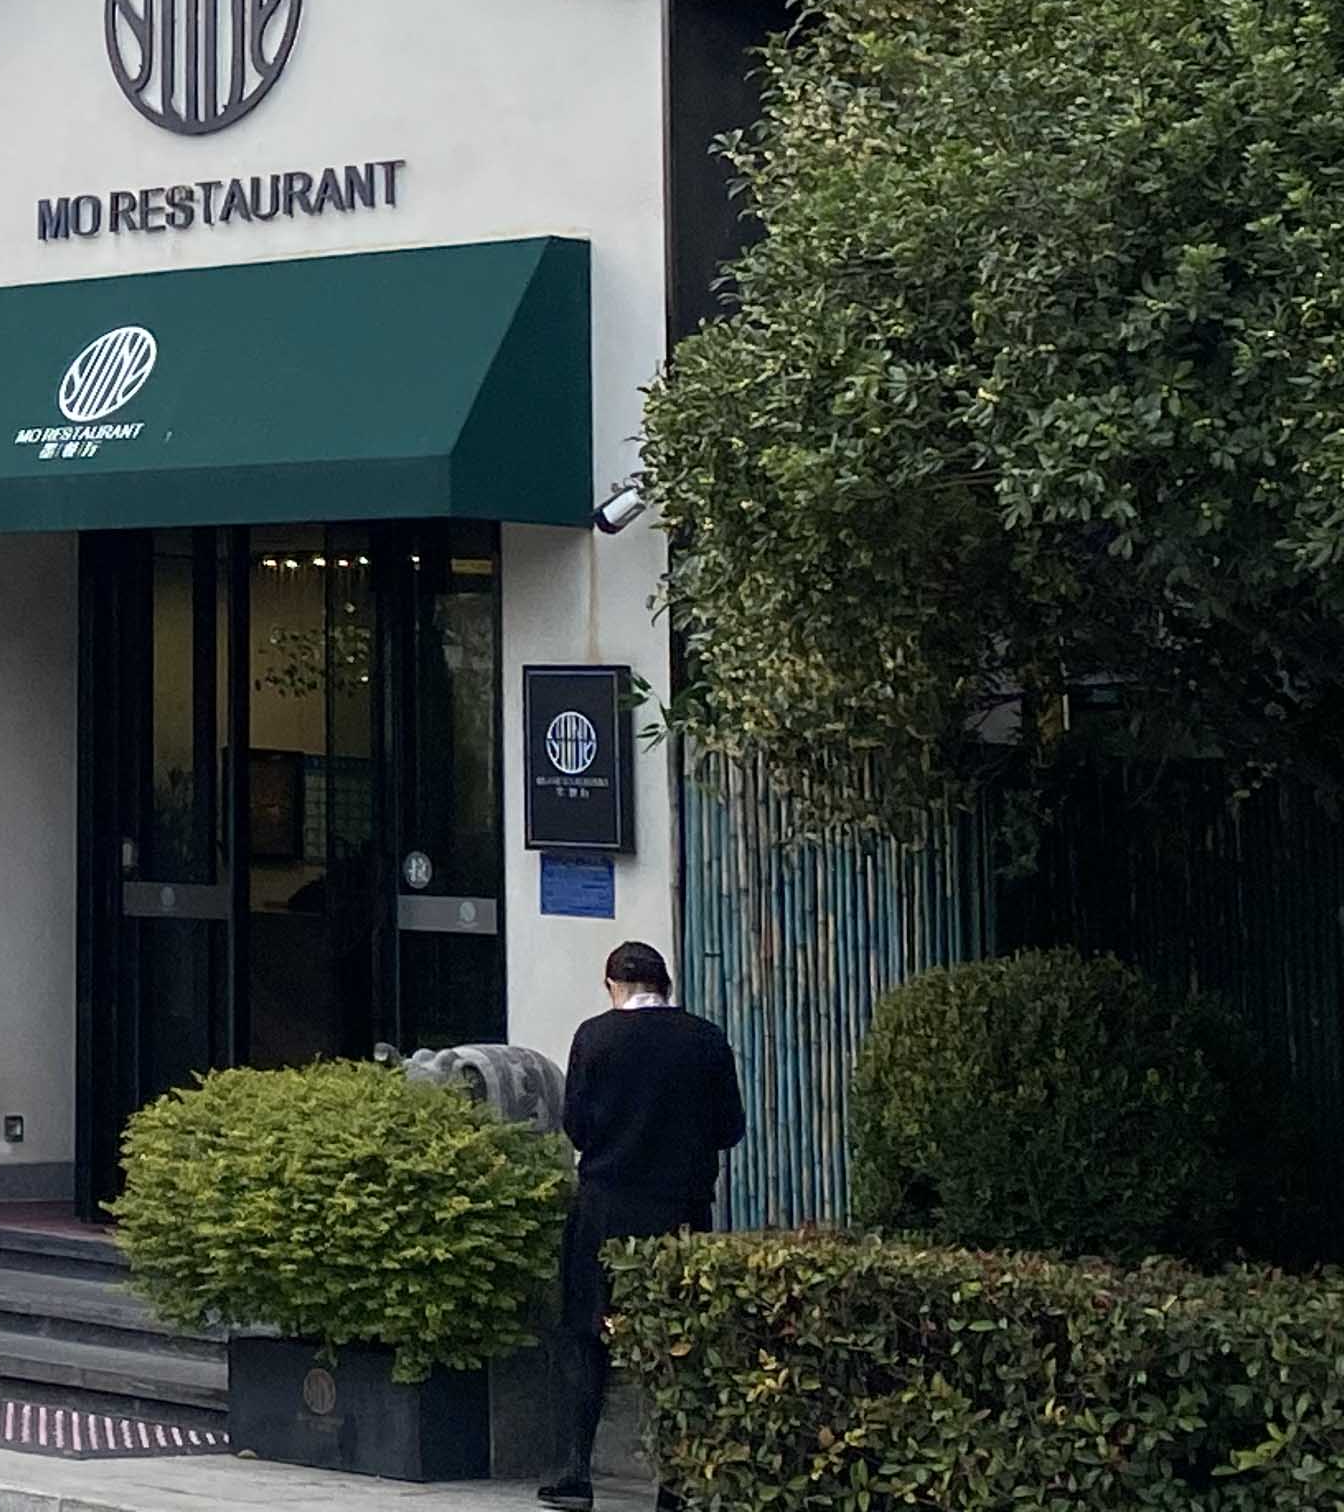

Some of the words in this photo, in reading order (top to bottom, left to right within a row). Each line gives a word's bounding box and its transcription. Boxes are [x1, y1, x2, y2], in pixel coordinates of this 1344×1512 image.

[37, 196, 101, 241] MO
[109, 160, 406, 234] RESTAURANT
[15, 428, 42, 444] MO
[41, 423, 144, 442] RESTAURANT
